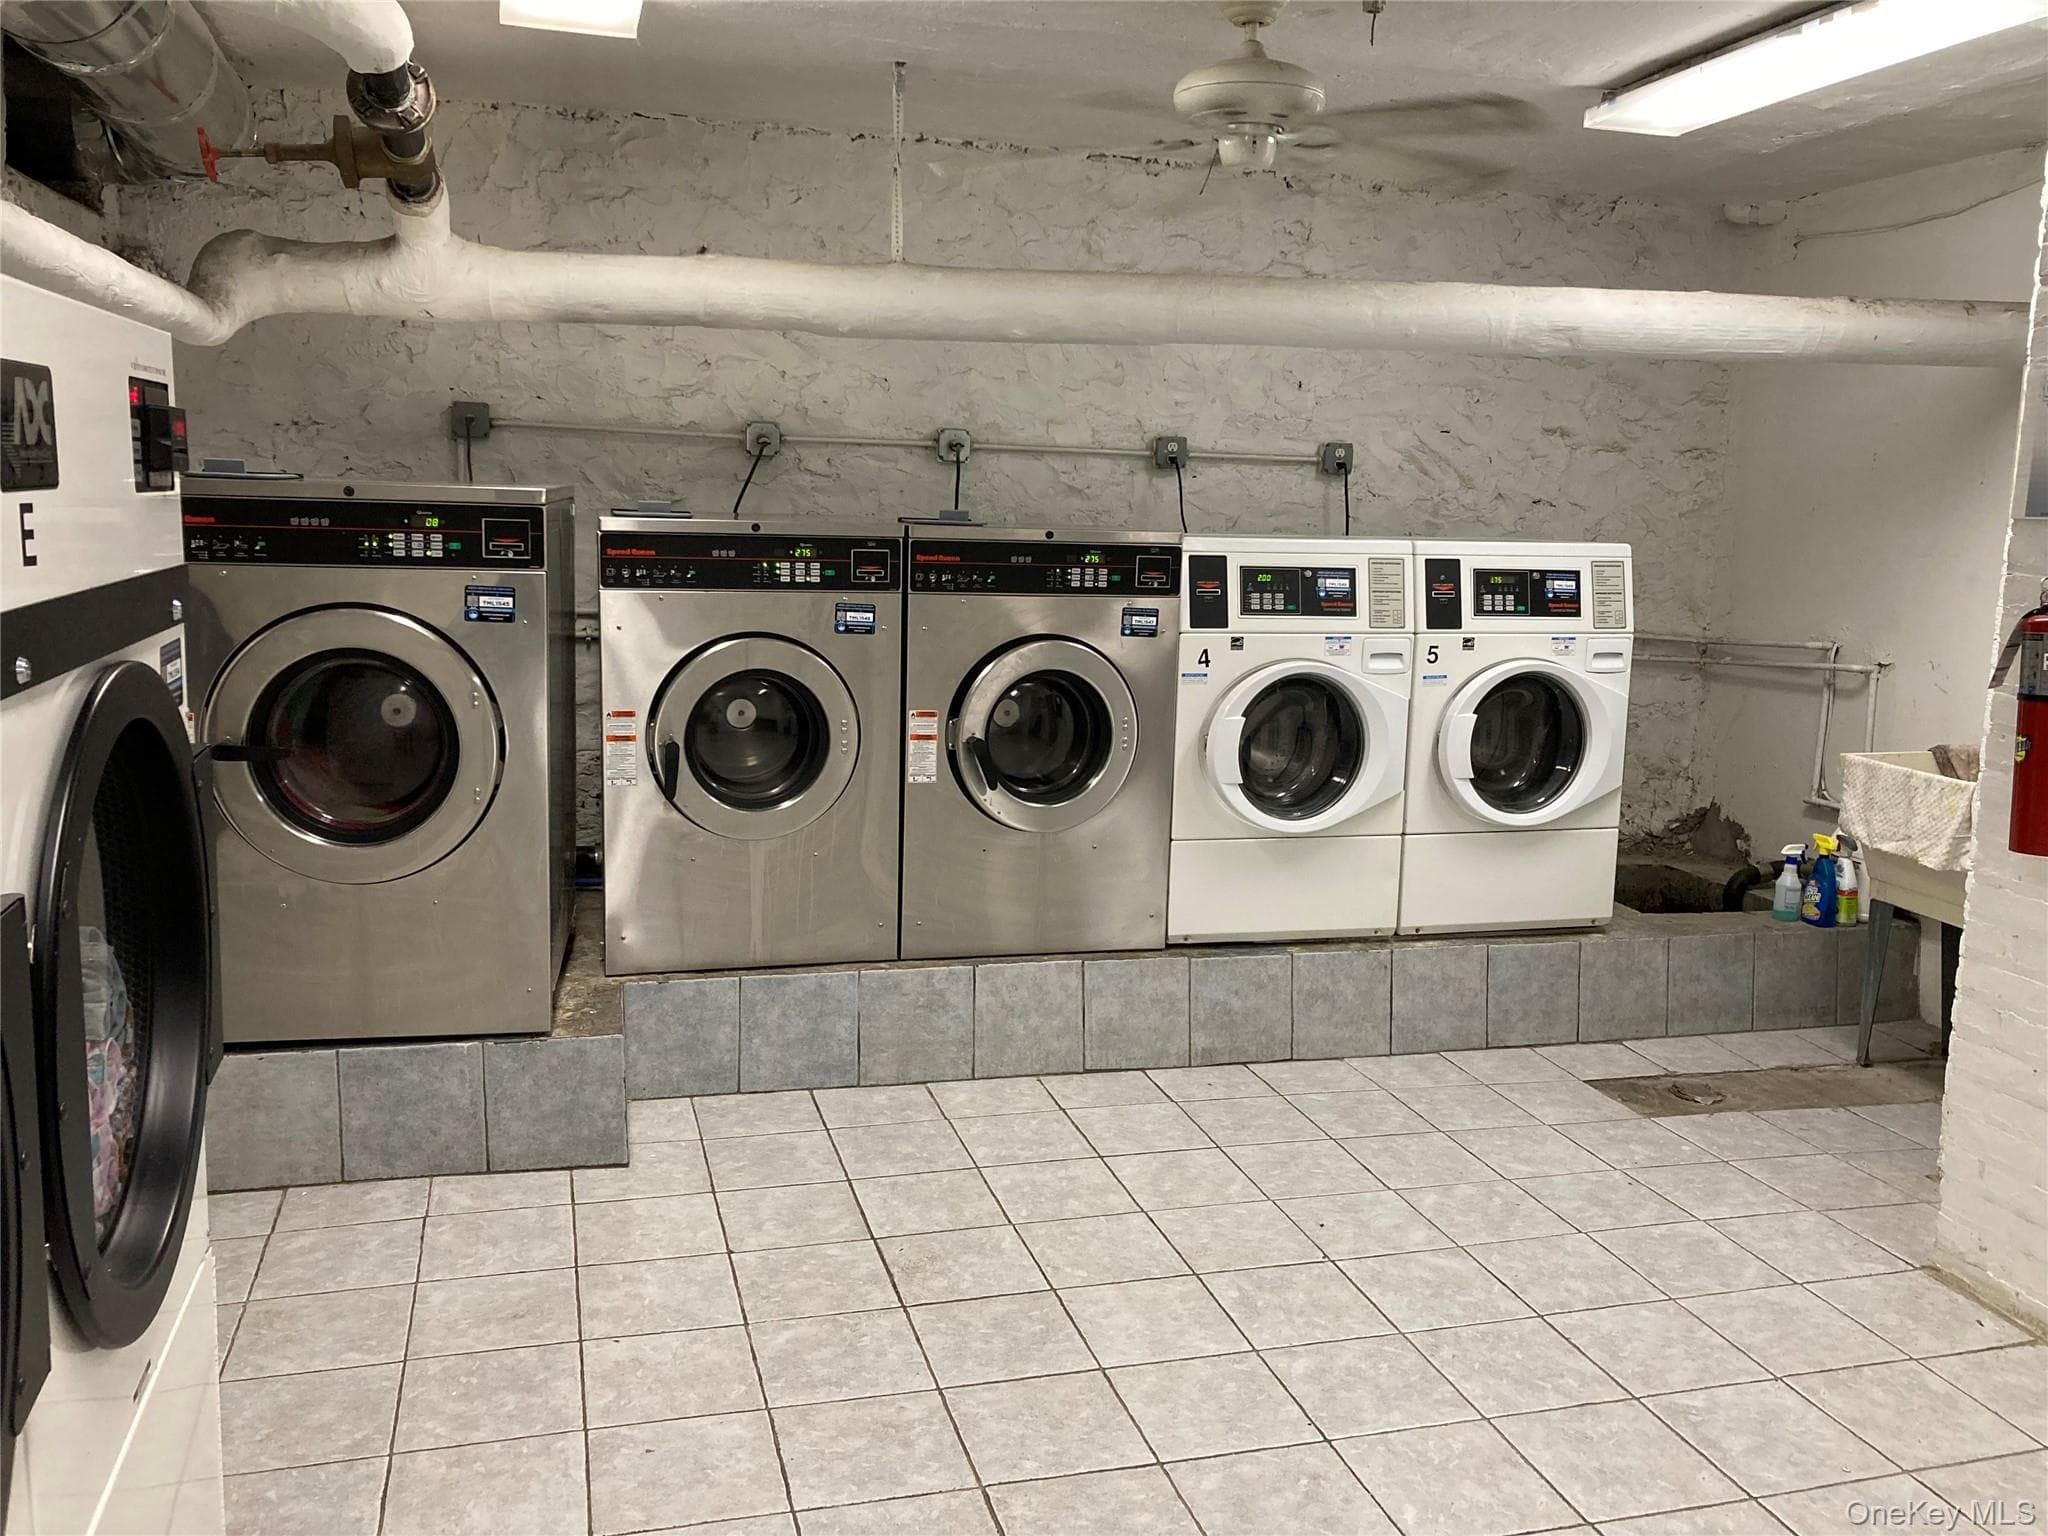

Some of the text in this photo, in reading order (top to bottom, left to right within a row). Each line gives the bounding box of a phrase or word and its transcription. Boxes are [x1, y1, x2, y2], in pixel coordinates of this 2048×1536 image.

[19, 502, 37, 566] E
[1198, 648, 1211, 668] 4
[1426, 645, 1439, 664] 5
